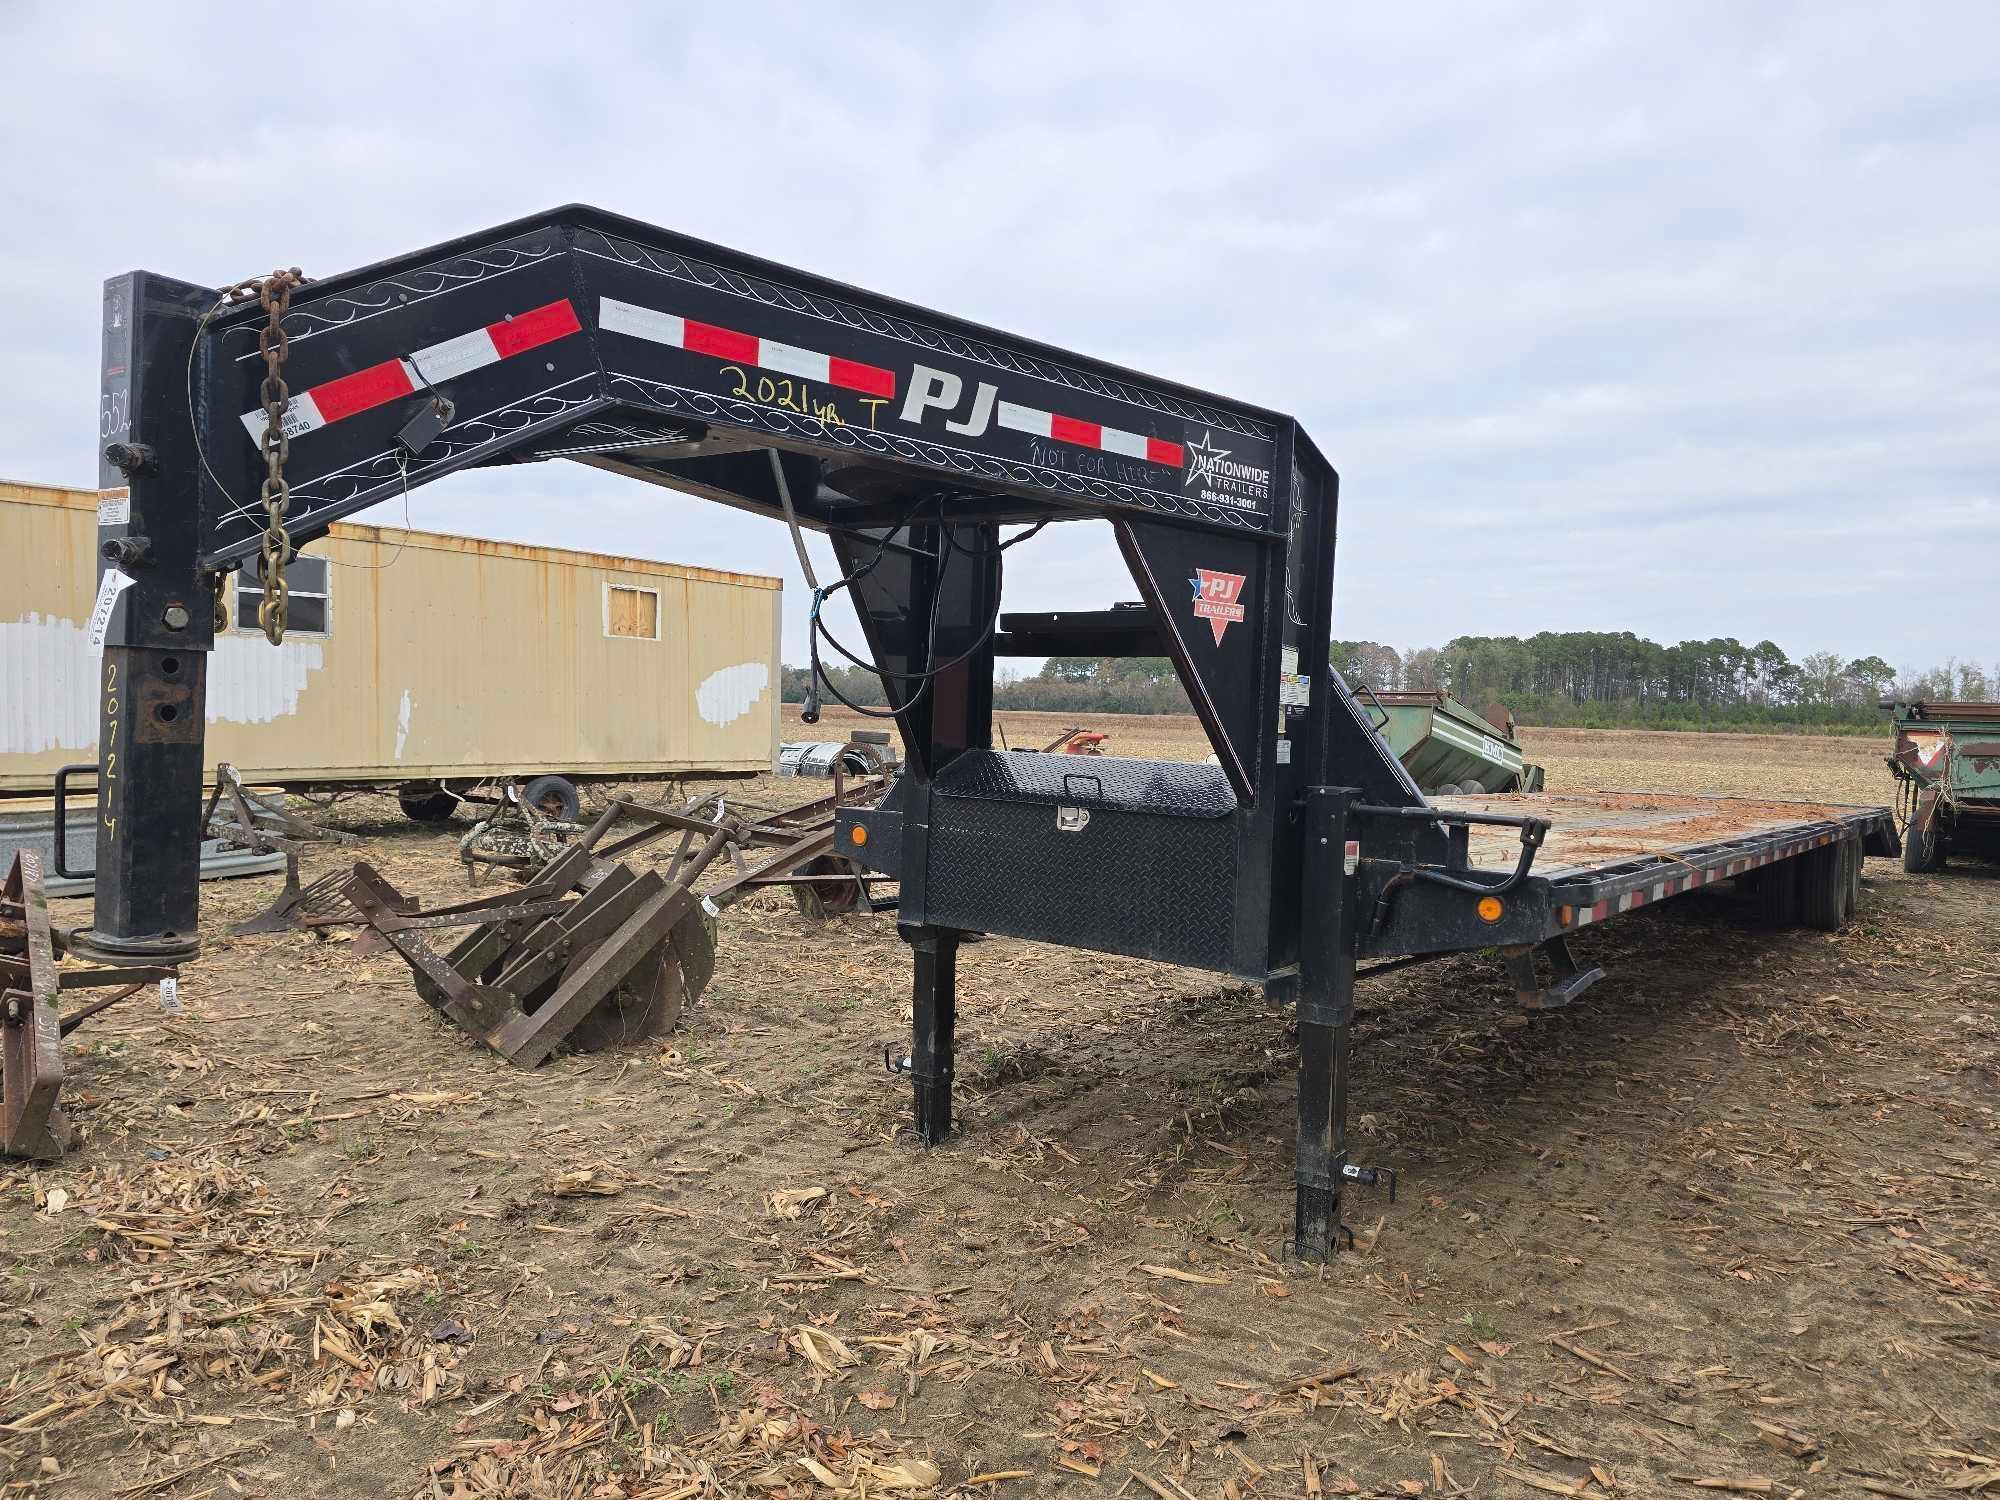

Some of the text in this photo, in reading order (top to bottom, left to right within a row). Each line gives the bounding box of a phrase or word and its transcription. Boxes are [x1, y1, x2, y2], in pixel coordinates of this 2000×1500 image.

[899, 363, 998, 437] PJ
[1198, 455, 1270, 484] NATIONWIDE
[1200, 489, 1256, 509] 866-931-3001
[1217, 479, 1268, 499] TRAILERS
[1208, 578, 1235, 599] PJ
[93, 586, 118, 646] 207214
[1199, 603, 1242, 617] TRAILERS
